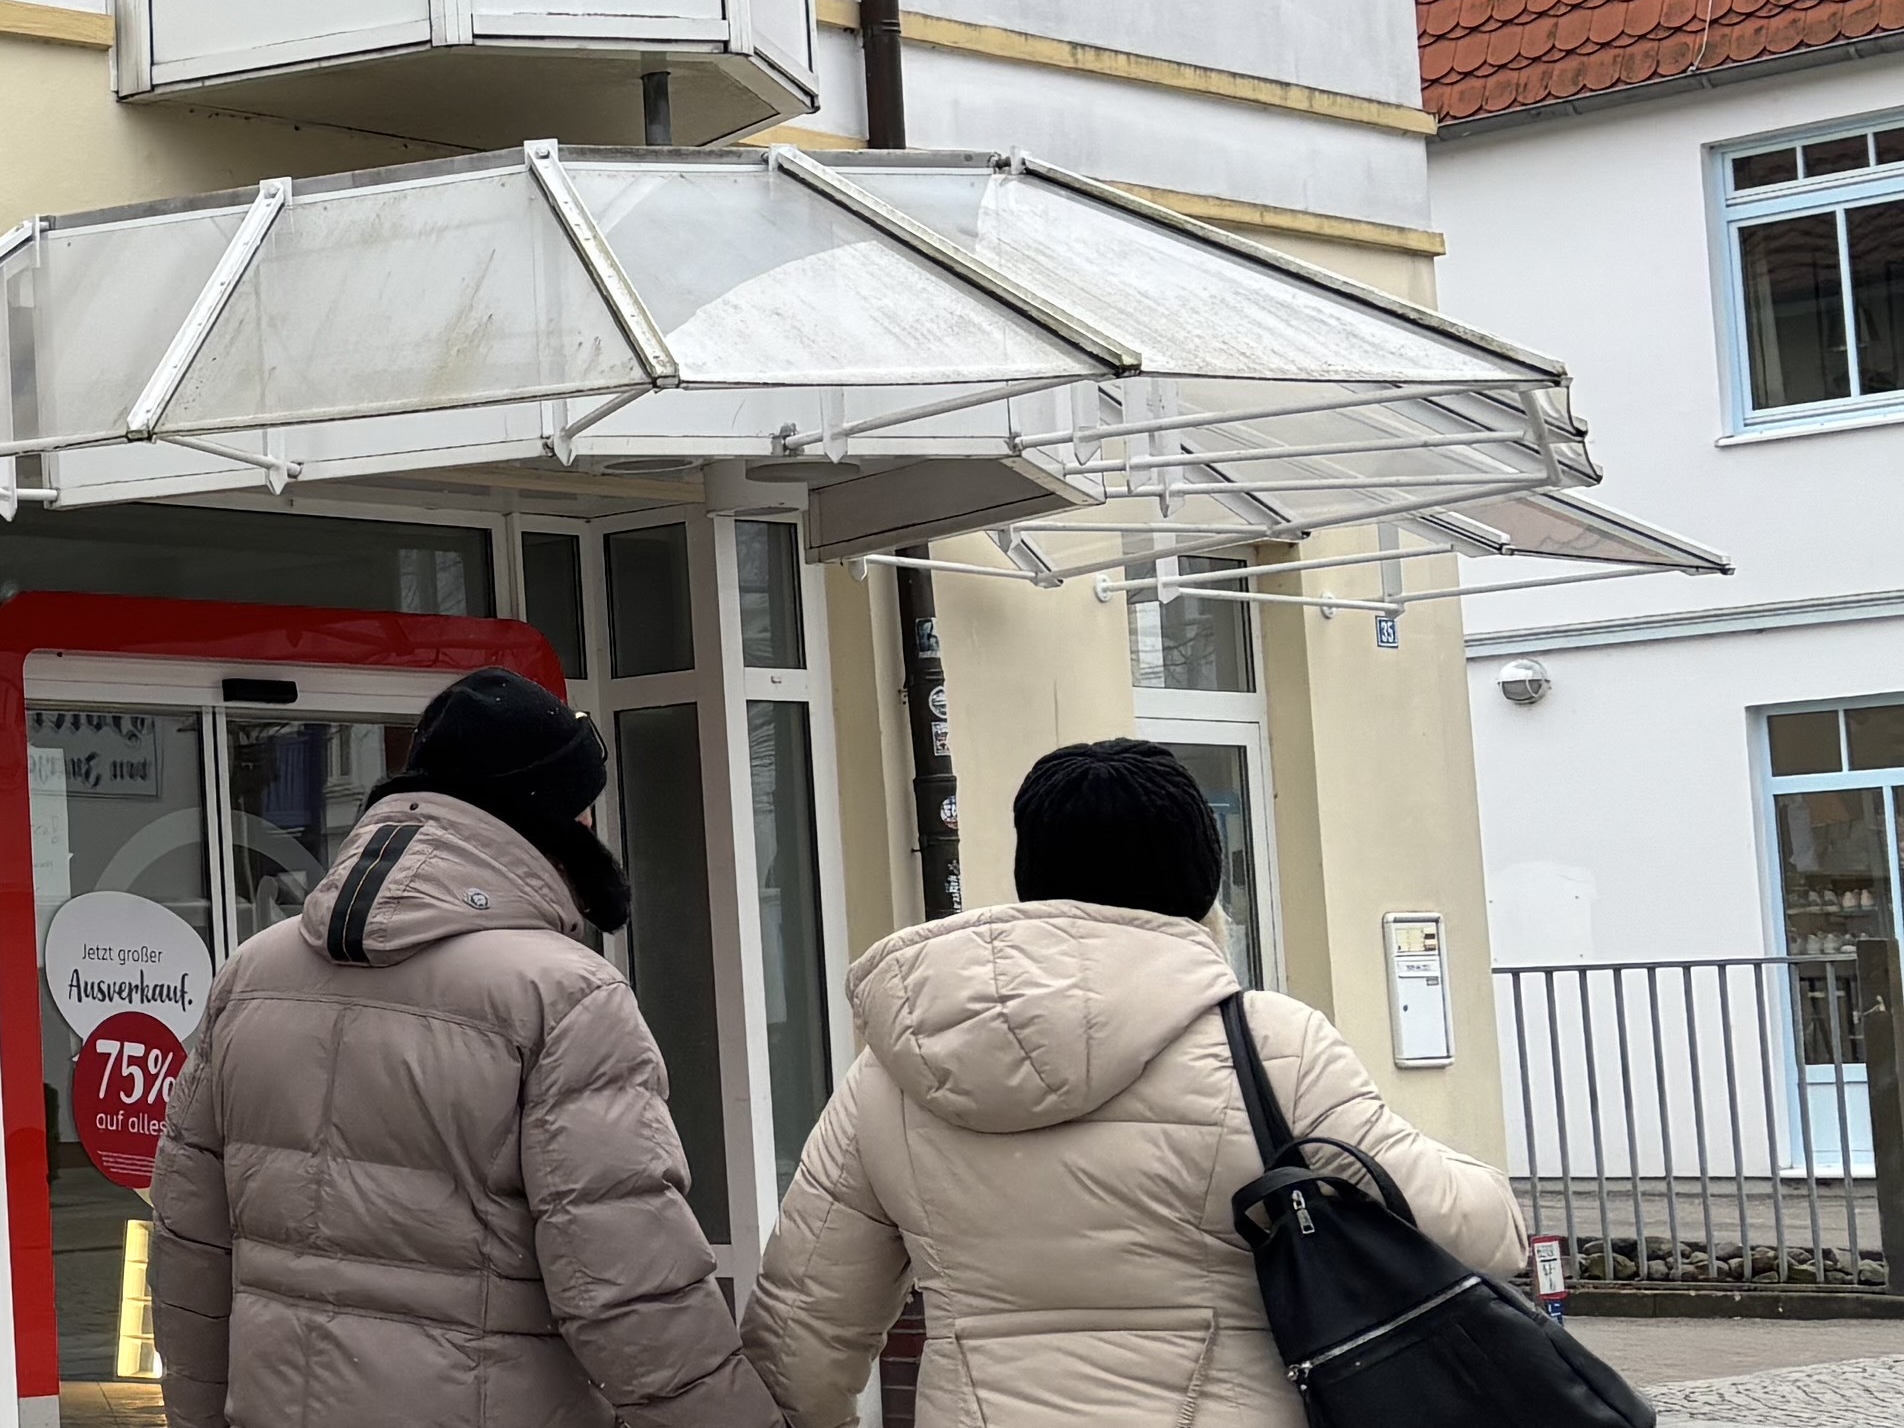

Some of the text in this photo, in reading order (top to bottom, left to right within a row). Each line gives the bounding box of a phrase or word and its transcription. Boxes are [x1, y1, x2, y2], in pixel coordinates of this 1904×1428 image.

[1380, 621, 1395, 643] 35
[82, 943, 163, 965] Jetzt großer
[68, 968, 193, 1012] Ausverkauf.
[96, 1039, 176, 1104] 75%
[96, 1110, 124, 1131] auf
